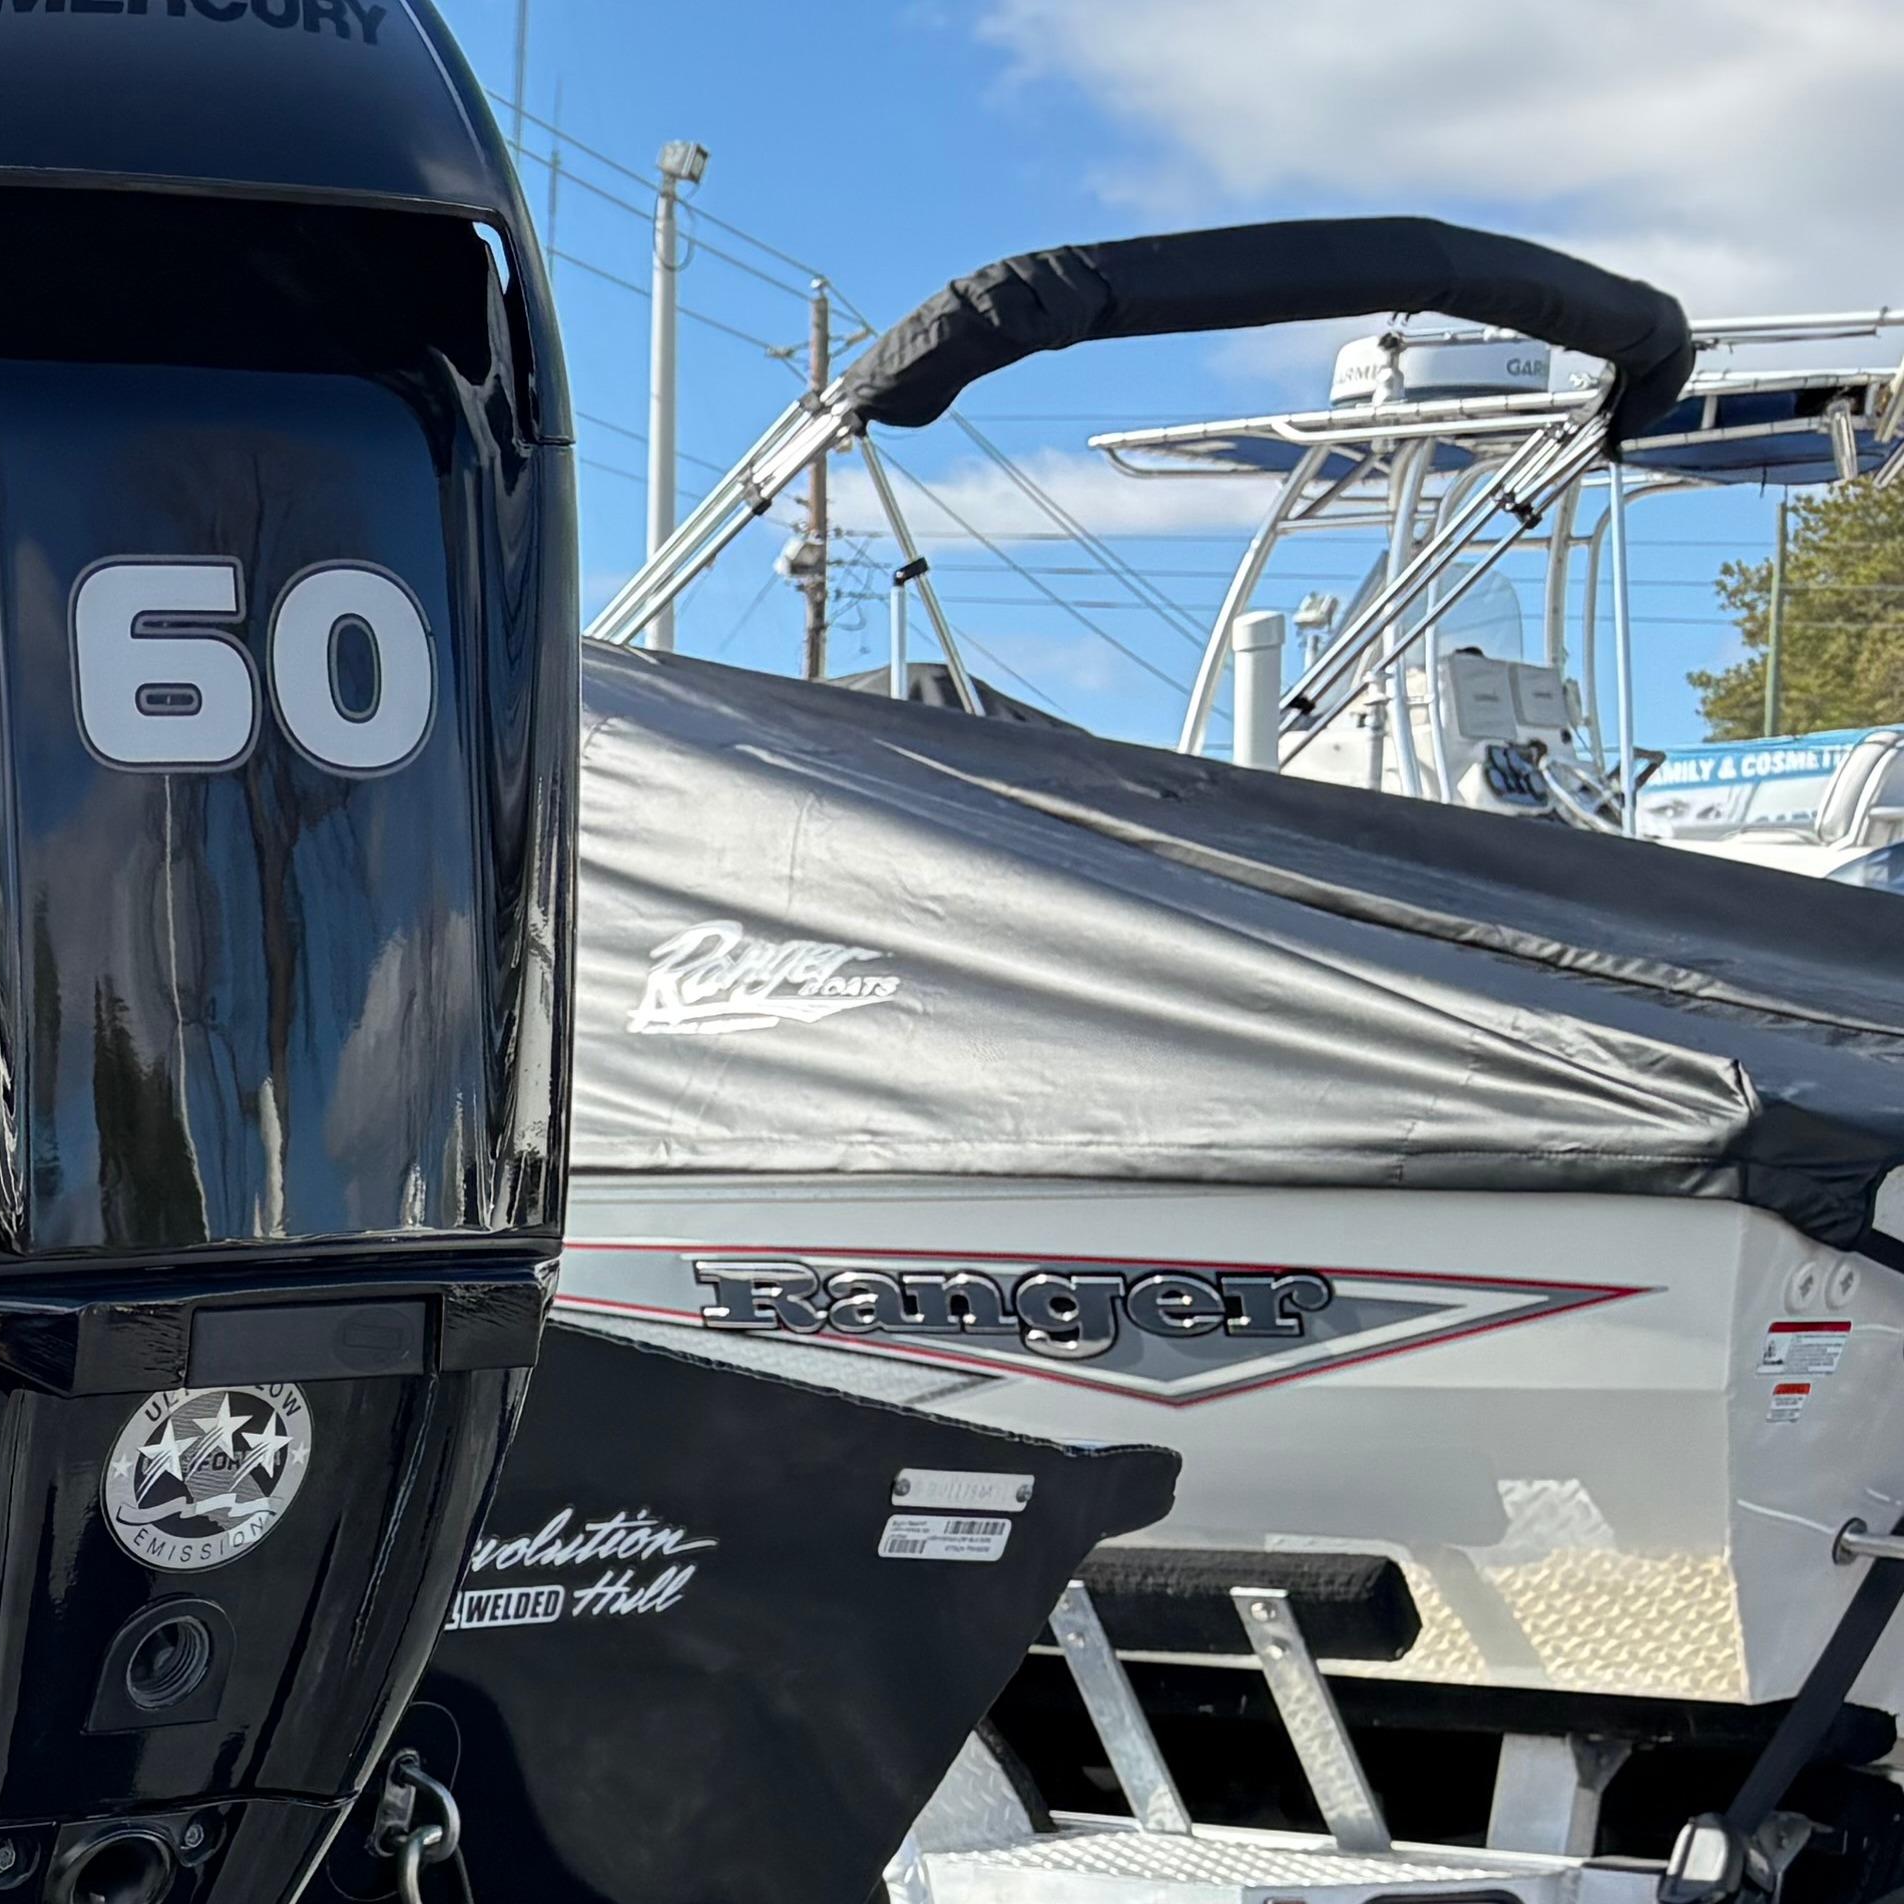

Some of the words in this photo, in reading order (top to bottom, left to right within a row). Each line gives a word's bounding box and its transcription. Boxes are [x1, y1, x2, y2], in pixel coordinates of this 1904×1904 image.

[68, 554, 439, 780] 60
[1649, 757, 1716, 786] AMILY
[693, 1260, 1333, 1359] Ranger
[464, 1588, 561, 1624] WELDED
[572, 1564, 696, 1617] Hull
